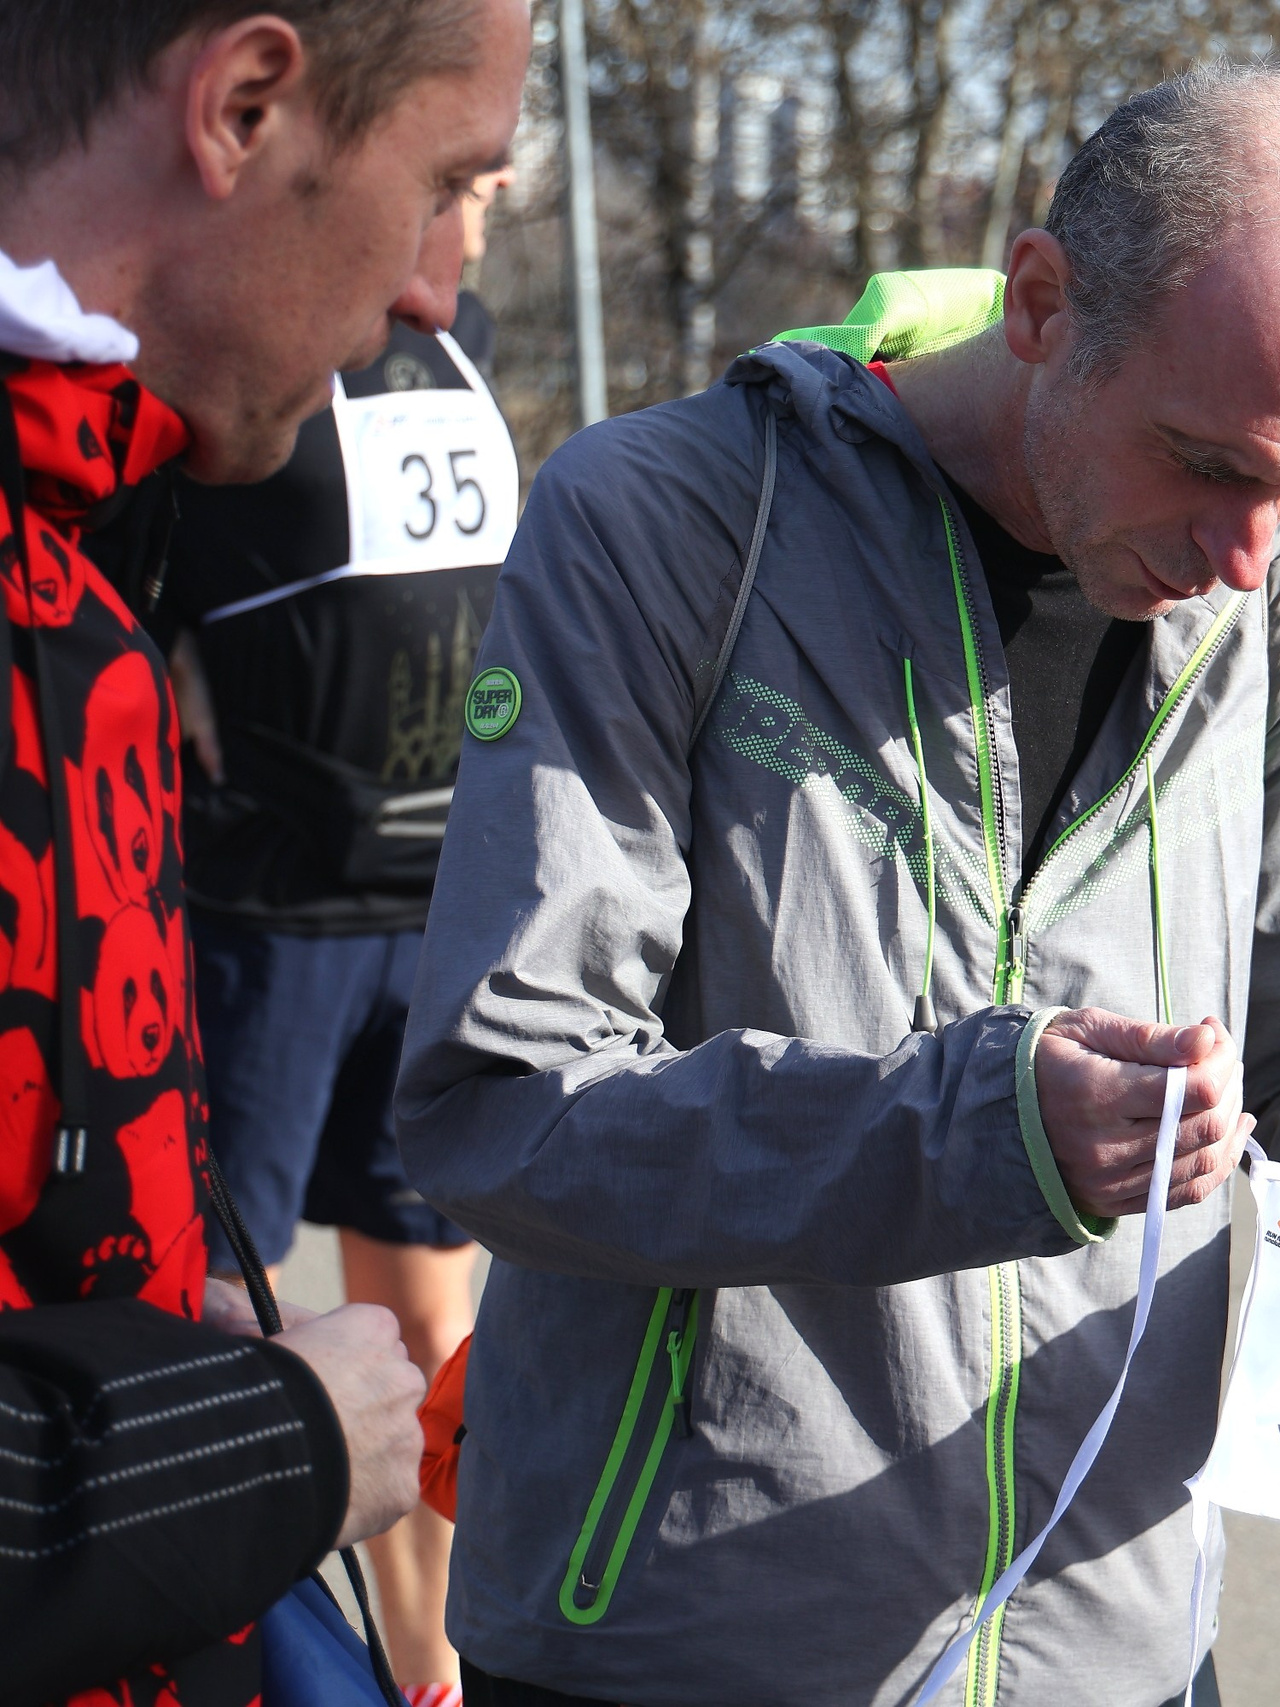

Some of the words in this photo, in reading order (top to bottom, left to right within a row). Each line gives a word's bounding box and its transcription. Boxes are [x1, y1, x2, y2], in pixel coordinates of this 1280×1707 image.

[401, 449, 486, 540] 35
[473, 689, 512, 705] SUPER
[1265, 1230, 1278, 1240] RUN
